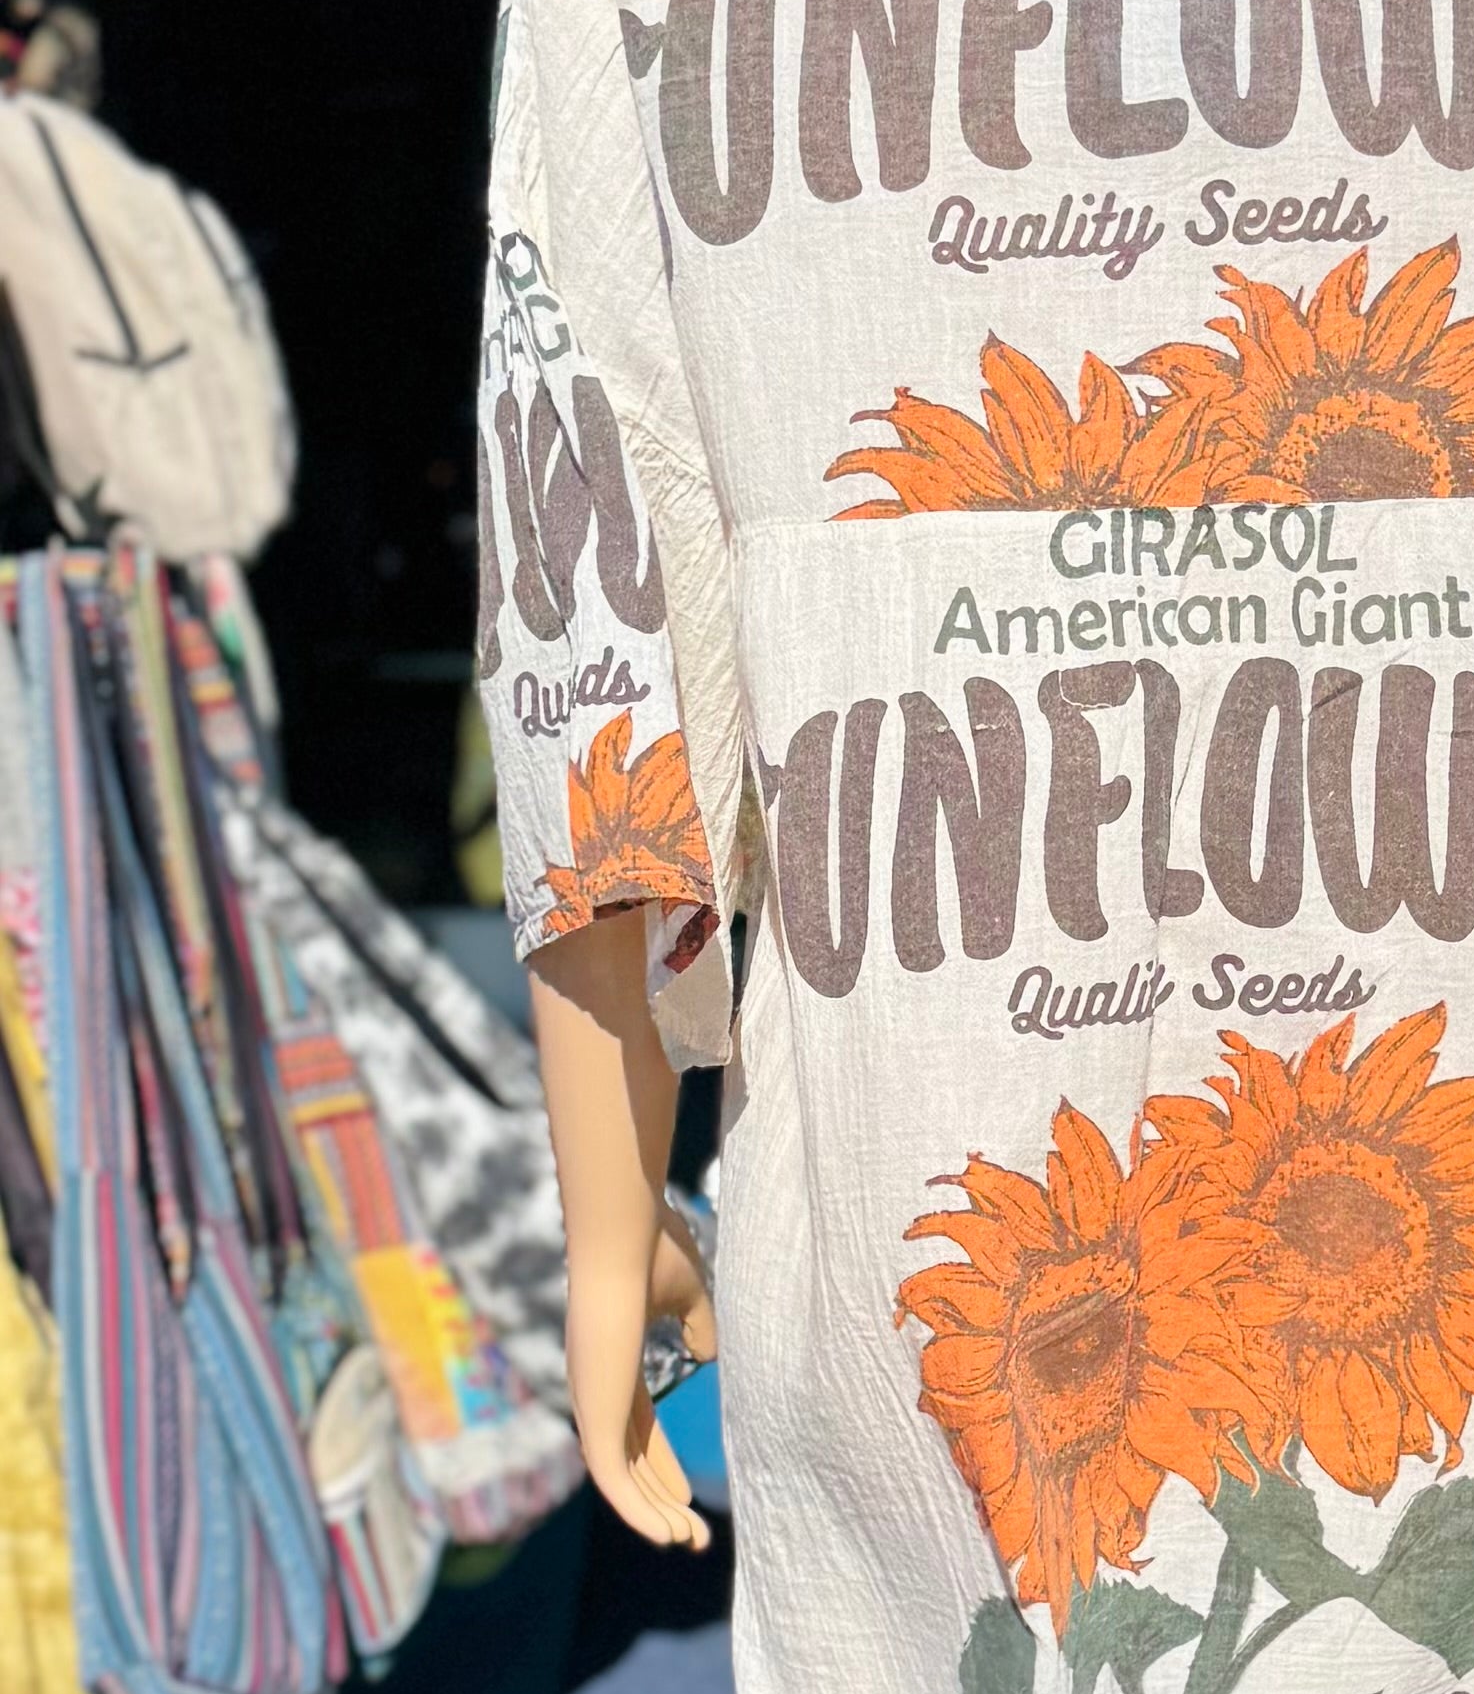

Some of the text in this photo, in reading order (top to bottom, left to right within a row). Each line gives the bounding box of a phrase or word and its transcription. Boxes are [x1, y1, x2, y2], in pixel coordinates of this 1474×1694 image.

[927, 177, 1389, 281] Quality Seeds
[1048, 503, 1357, 579] GIRASOL
[933, 575, 1473, 655] American Giant
[1007, 953, 1377, 1040] Qualit Seeds
